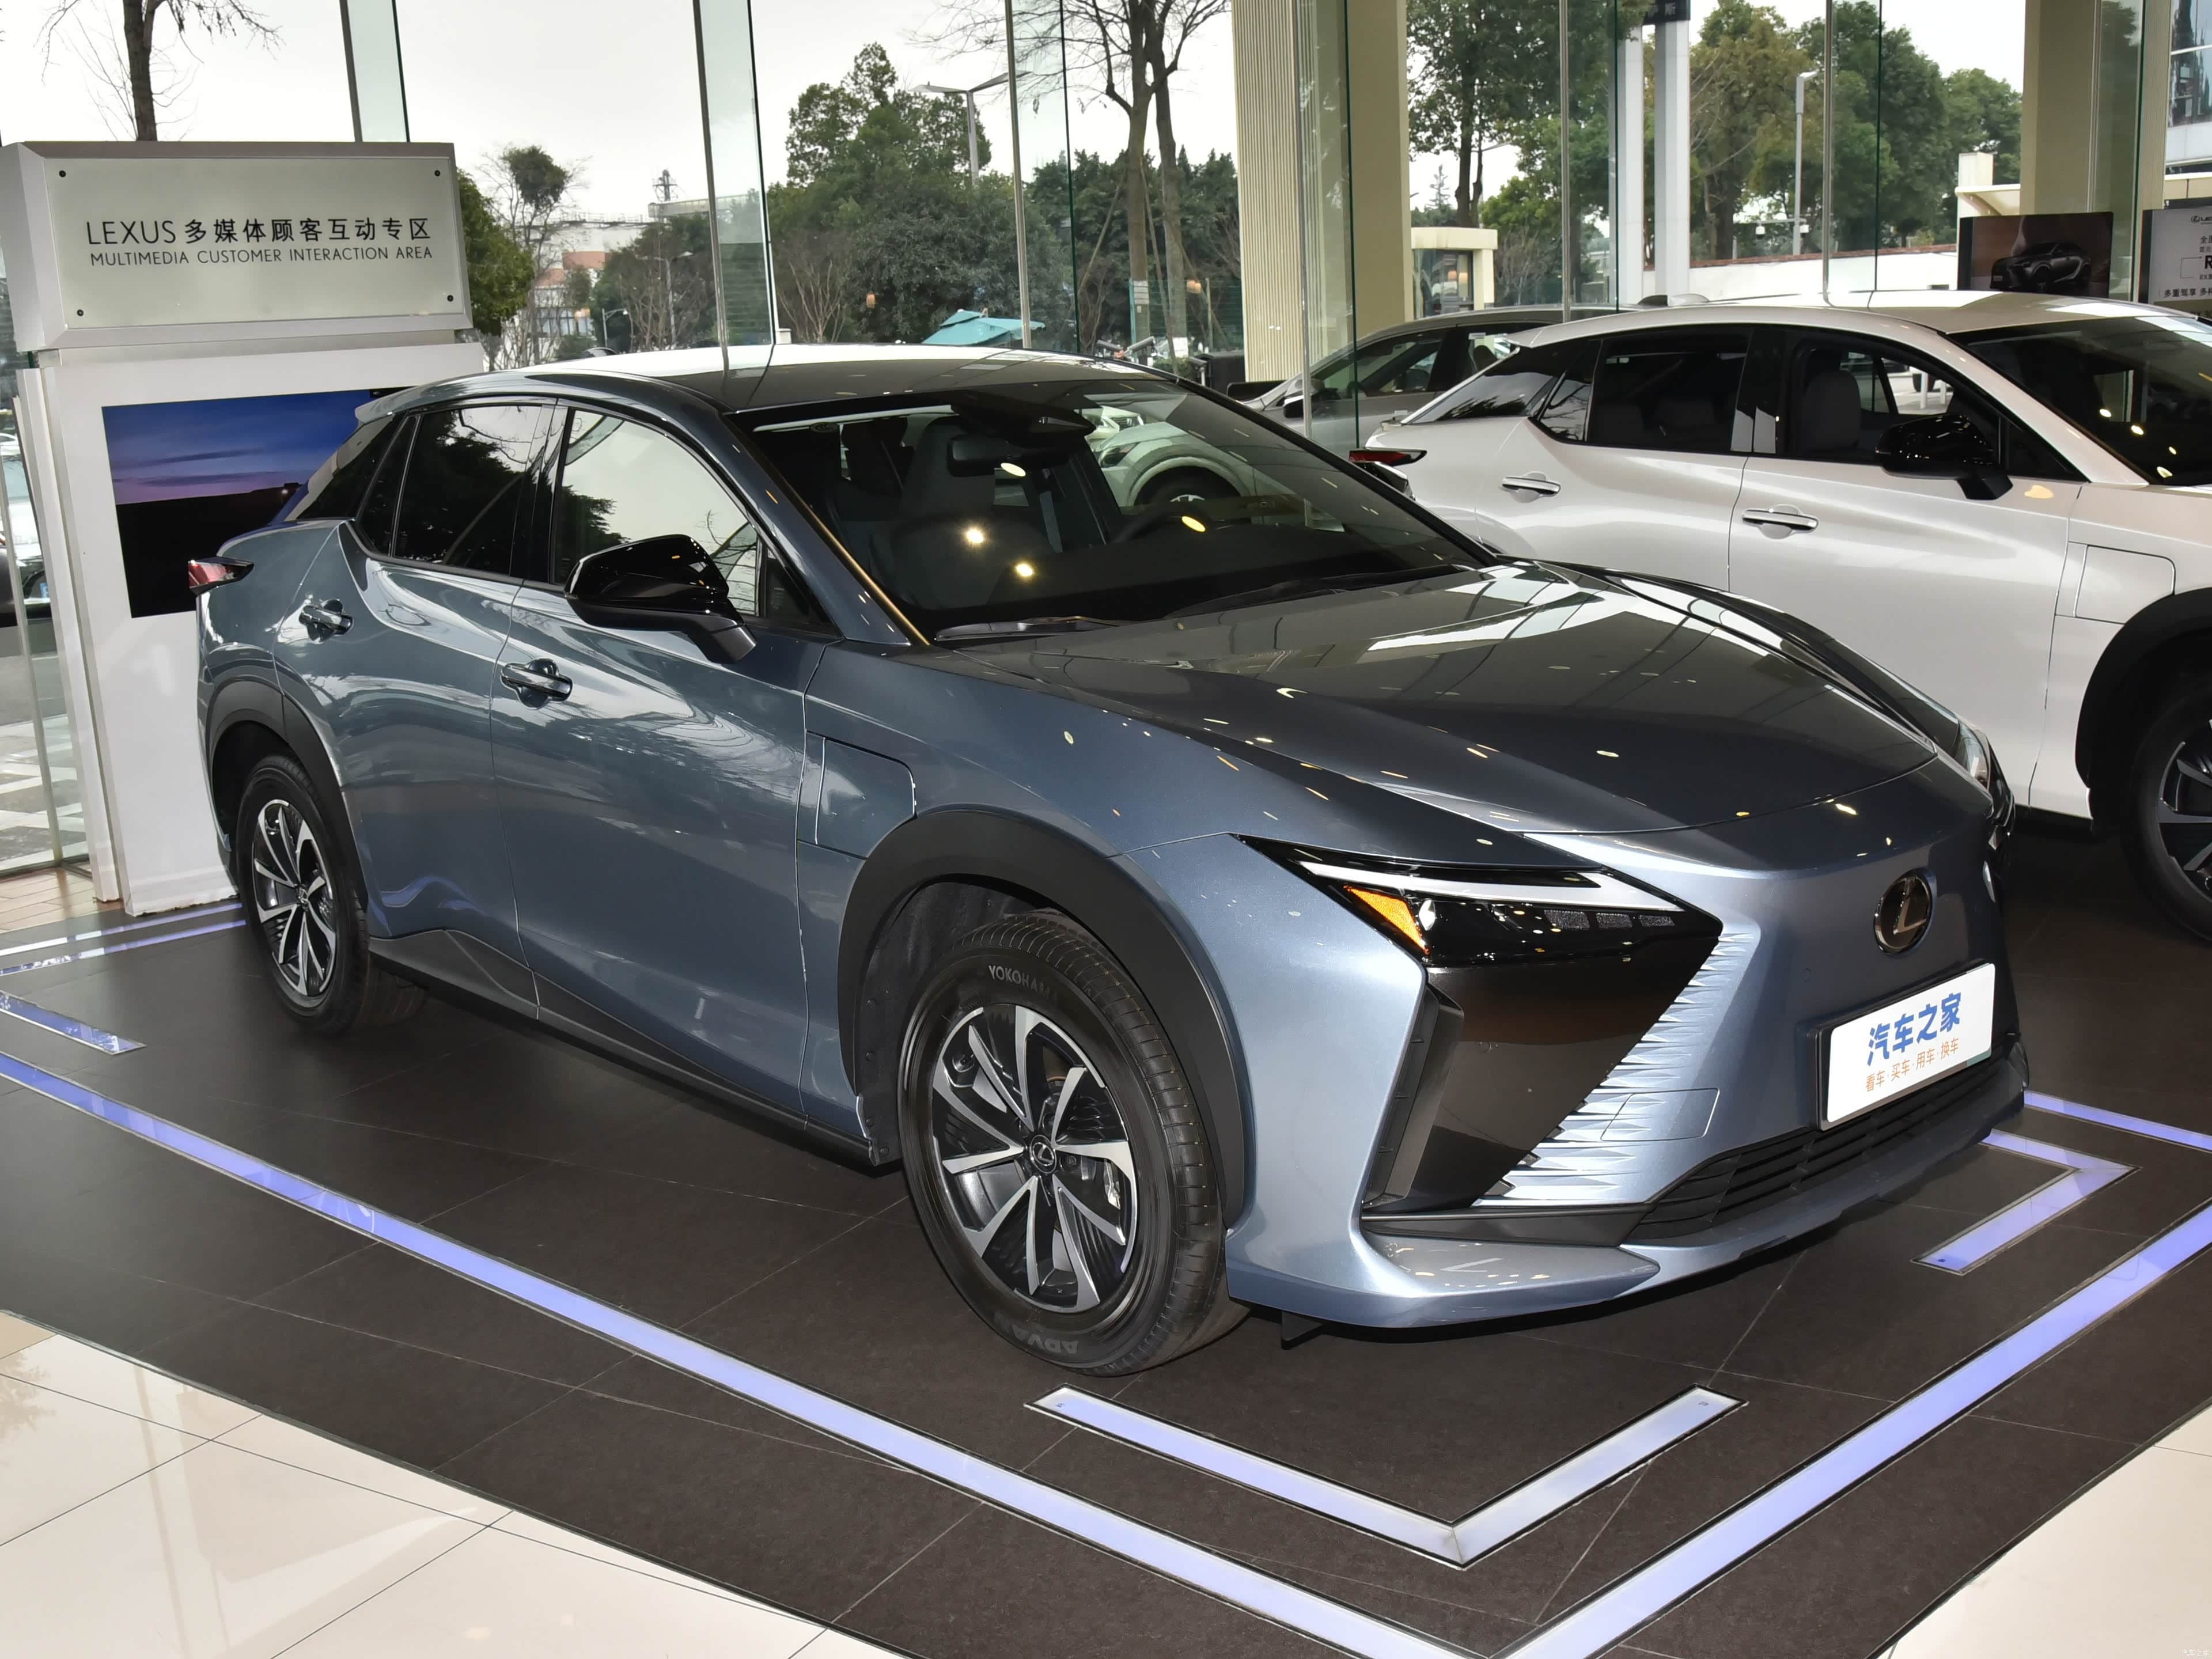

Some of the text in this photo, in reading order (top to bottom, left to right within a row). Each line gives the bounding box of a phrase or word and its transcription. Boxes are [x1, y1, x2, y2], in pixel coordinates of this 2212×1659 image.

[86, 217, 430, 244] LEXUS 多媒体顾客互动专区
[90, 247, 432, 266] MULTIMEDIA CUSTOMER INTERACTION AREA
[1867, 992, 1961, 1066] 汽车之家
